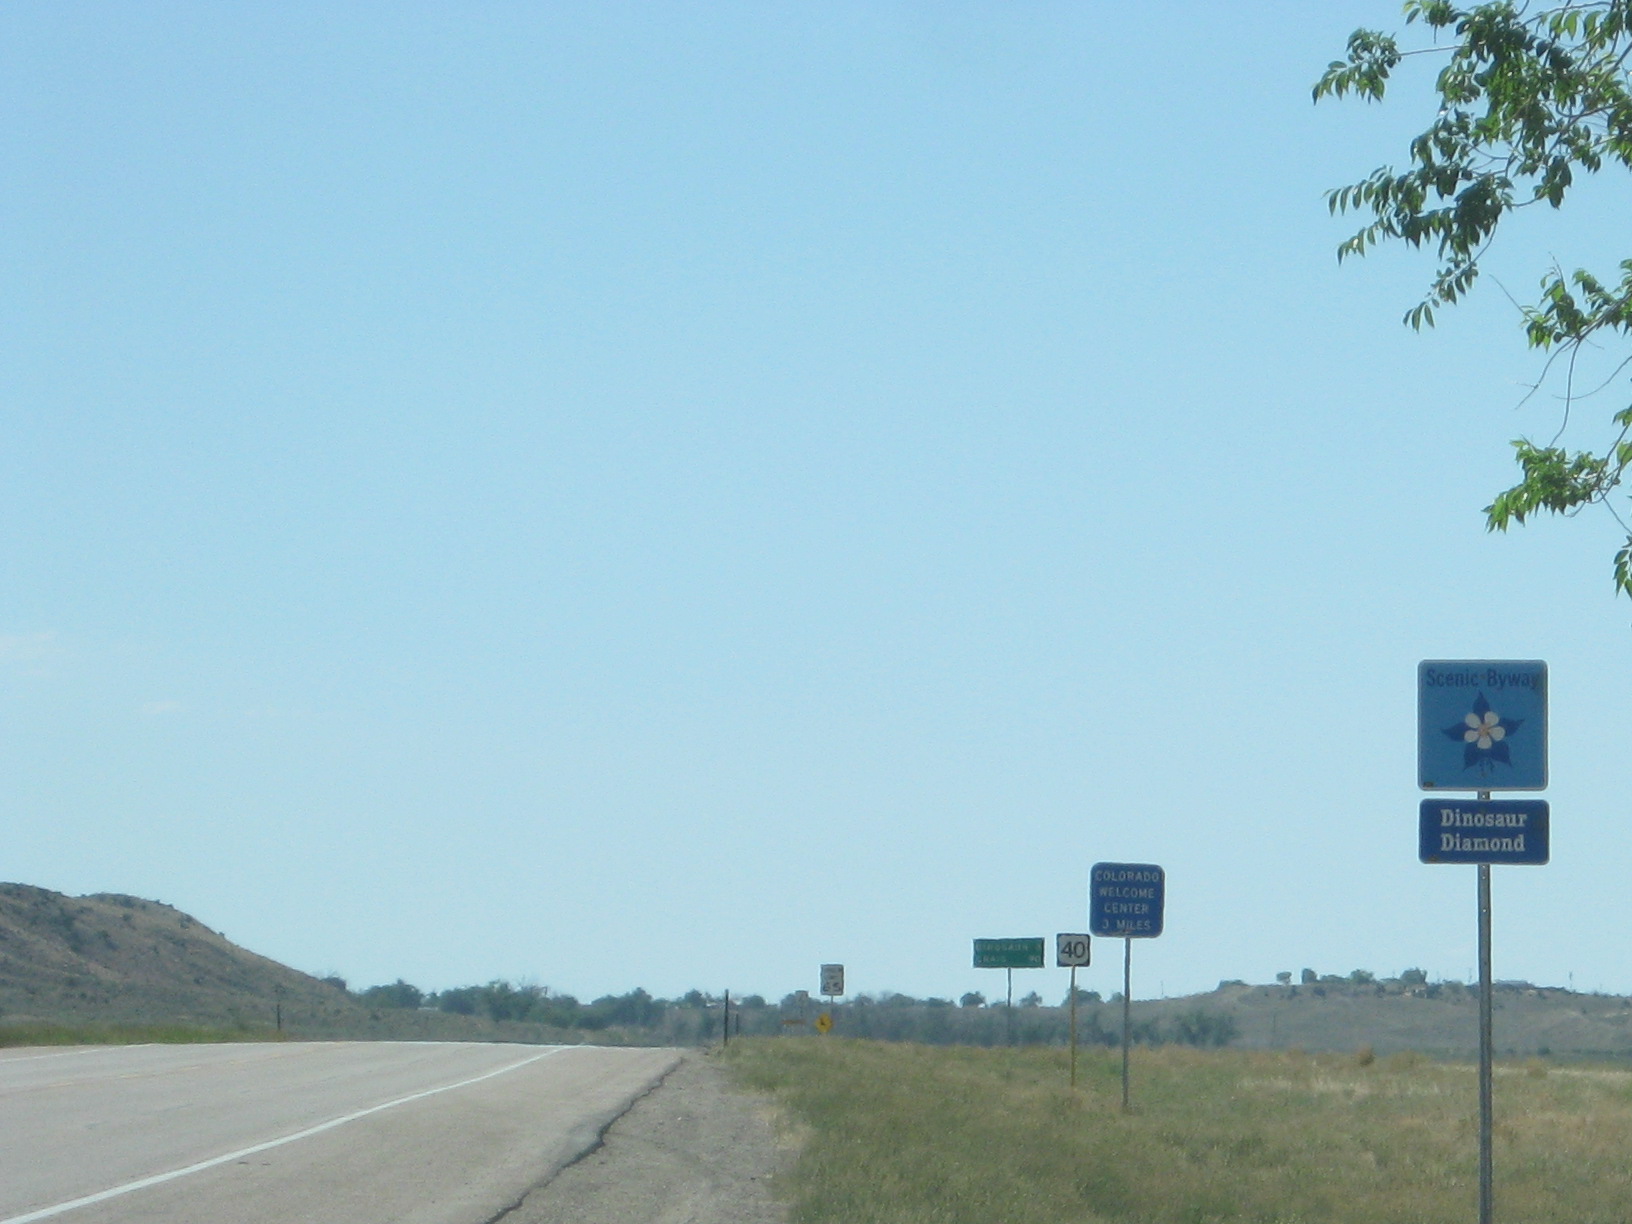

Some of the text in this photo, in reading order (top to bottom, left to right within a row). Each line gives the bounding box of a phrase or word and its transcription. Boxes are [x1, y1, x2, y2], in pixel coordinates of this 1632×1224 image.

[1426, 668, 1540, 690] Scenic Byway
[1440, 809, 1528, 827] Dinosaur
[1440, 833, 1525, 852] Diamond
[1095, 870, 1160, 882] COLORADO
[1099, 887, 1155, 898] WELCOME
[1104, 902, 1149, 915] CENTER
[1116, 919, 1152, 931] MILES
[1061, 941, 1085, 958] 40
